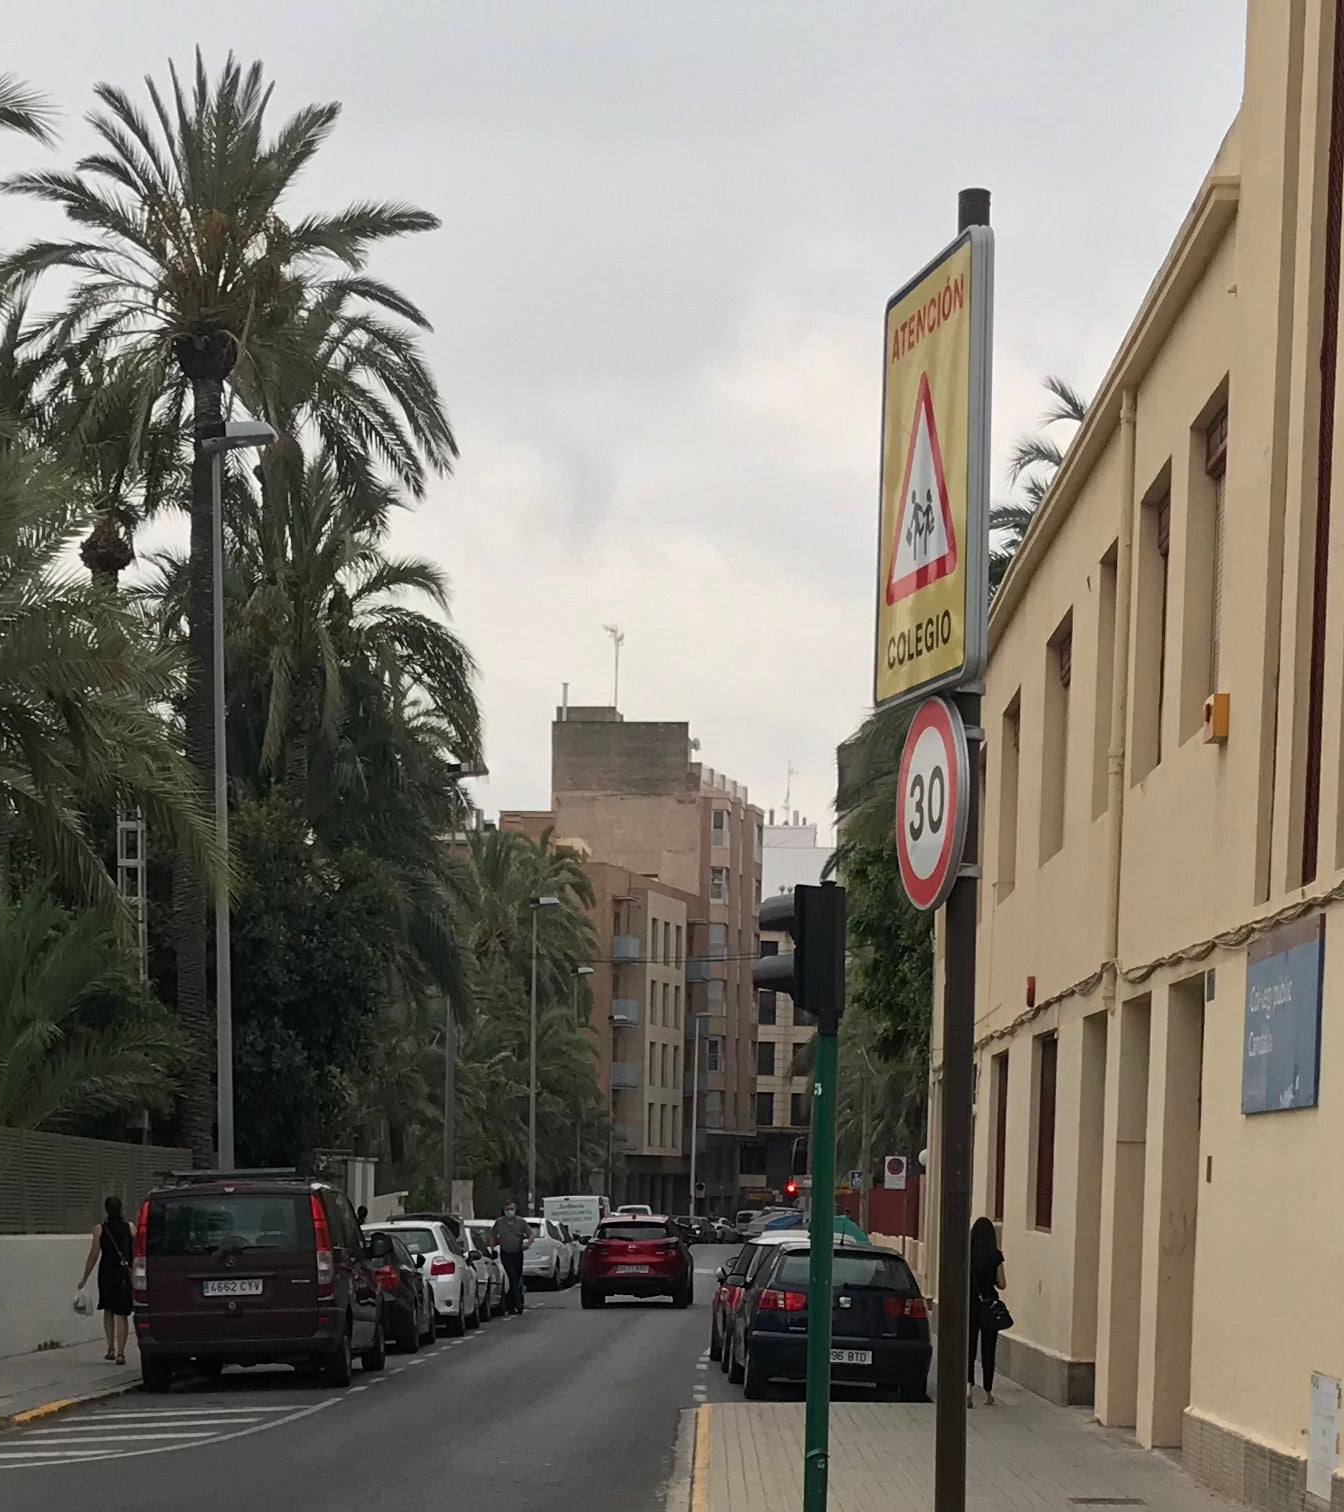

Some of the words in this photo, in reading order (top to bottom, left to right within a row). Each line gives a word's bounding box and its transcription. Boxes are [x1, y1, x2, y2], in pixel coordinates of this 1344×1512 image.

[891, 273, 964, 365] ATENCIÓN
[887, 608, 952, 670] COLEGIO
[909, 765, 945, 842] 30
[831, 1350, 844, 1361] 96
